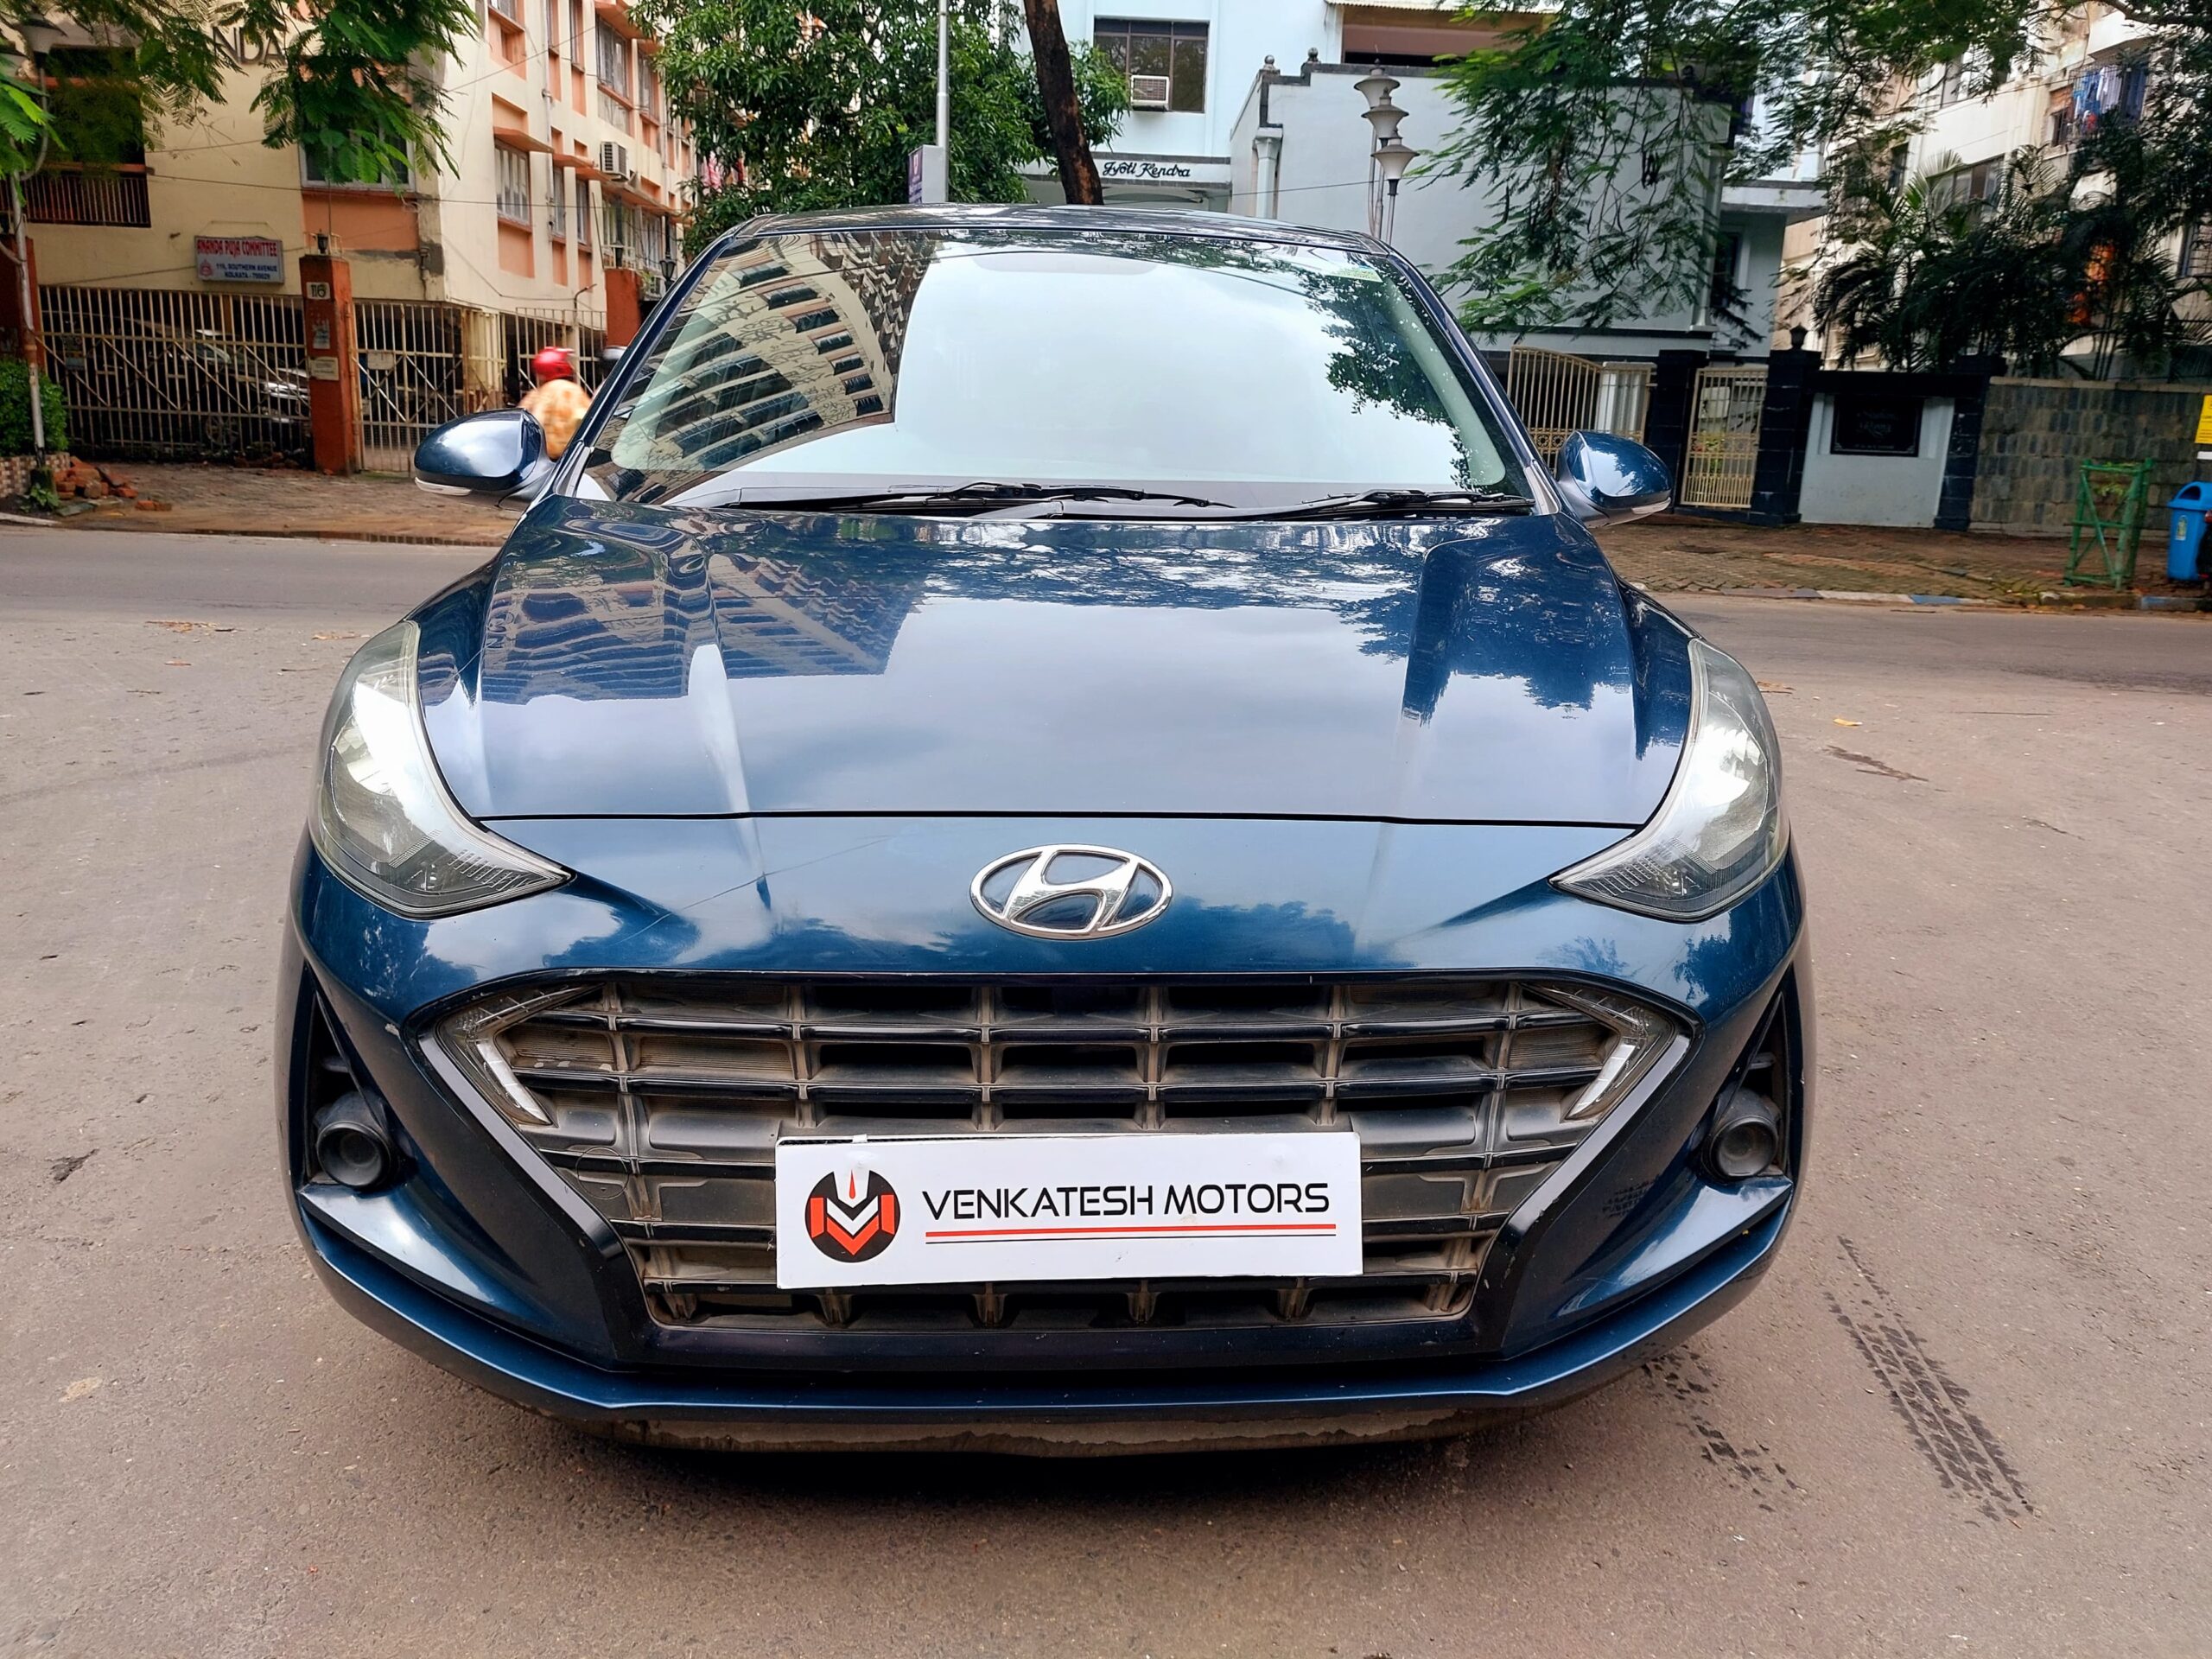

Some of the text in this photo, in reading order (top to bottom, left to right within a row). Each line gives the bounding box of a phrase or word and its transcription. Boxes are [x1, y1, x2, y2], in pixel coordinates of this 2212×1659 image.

[1135, 162, 1191, 178] Kendra
[242, 241, 277, 257] COMMITTEE
[921, 1182, 1330, 1220] VENKATESH MOTORS
